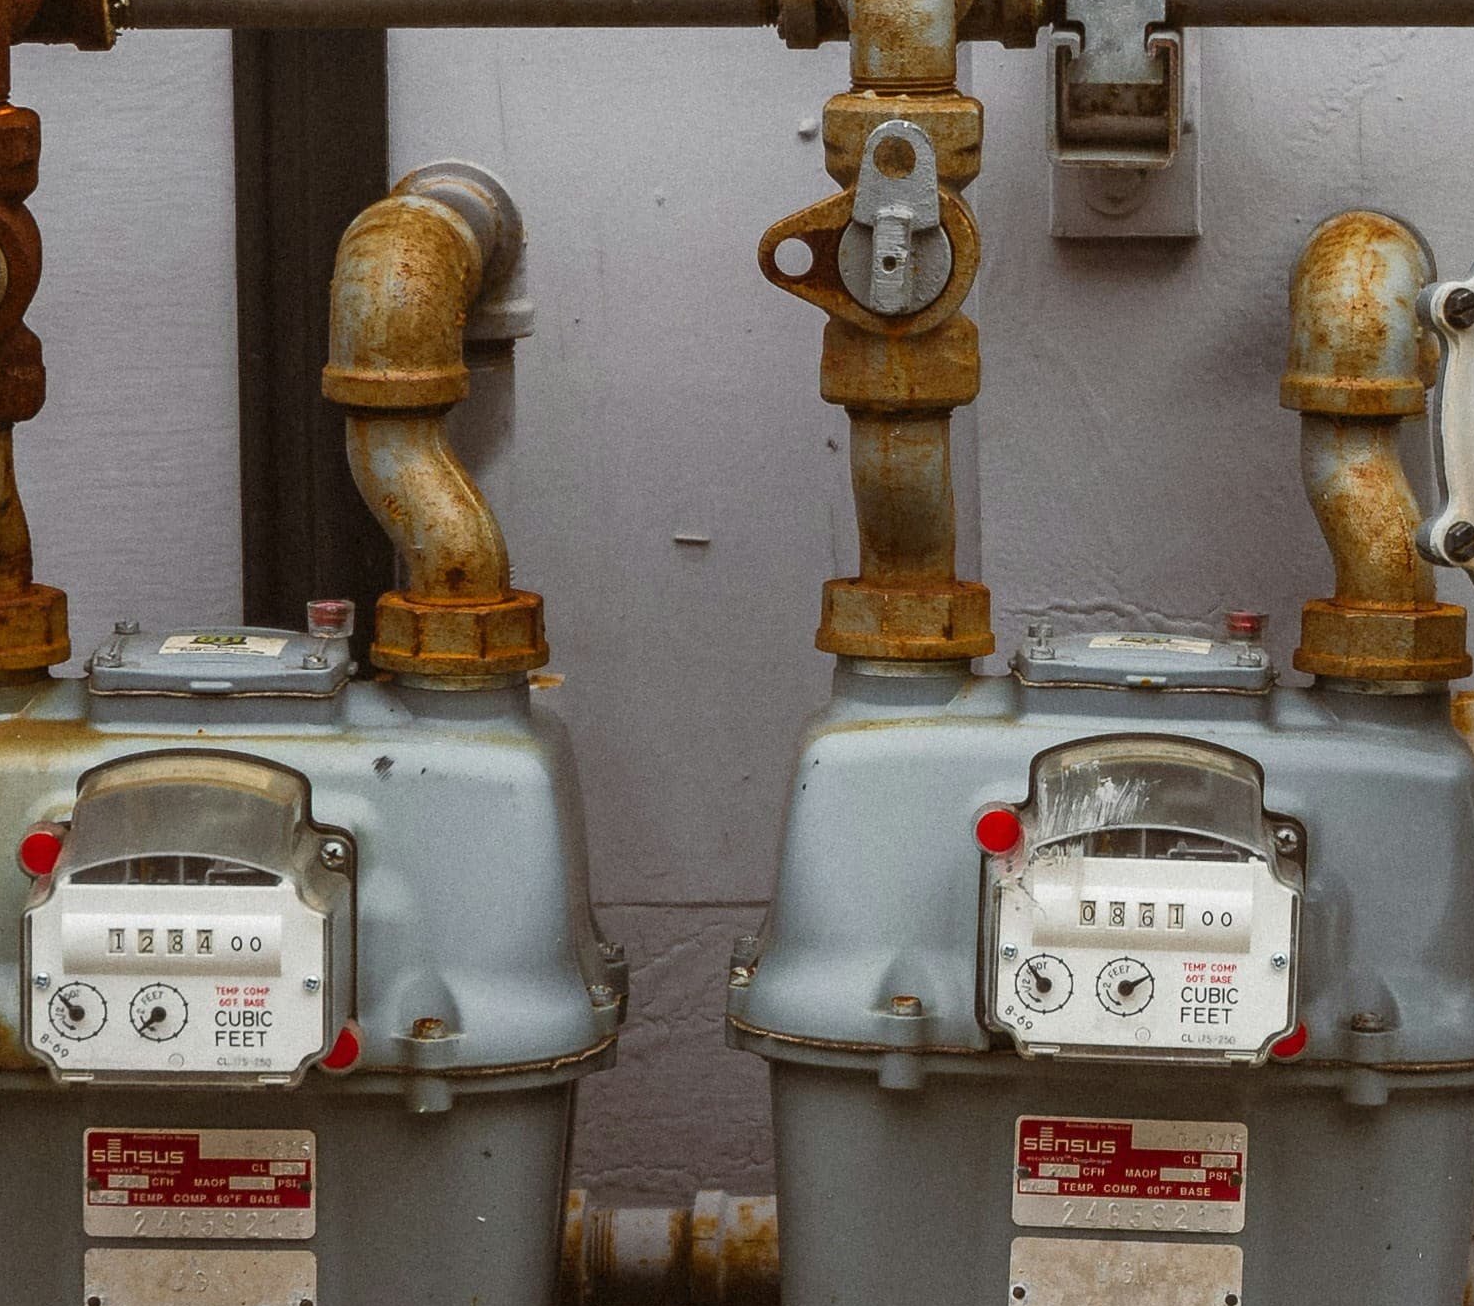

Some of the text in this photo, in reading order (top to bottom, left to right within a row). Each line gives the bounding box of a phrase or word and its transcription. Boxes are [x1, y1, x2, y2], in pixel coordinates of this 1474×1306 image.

[1081, 904, 1182, 927] 0861
[113, 931, 214, 954] 1284
[1107, 964, 1131, 979] FEET
[1210, 975, 1233, 984] BASE
[140, 990, 164, 1005] FEET
[243, 997, 266, 1008] BASE
[1180, 986, 1239, 1005] CUBIC
[214, 1010, 273, 1028] CUBIC
[1004, 1005, 1034, 1031] 8-69
[1180, 1006, 1233, 1025] FEET
[39, 1032, 70, 1060] 8-69
[215, 1030, 268, 1047] FEET
[1183, 1155, 1198, 1165] CL
[251, 1163, 267, 1173] CL
[1082, 1167, 1105, 1177] CFH
[1125, 1168, 1158, 1178] MAOP
[1208, 1171, 1228, 1181] PSI
[151, 1177, 174, 1187] CFH
[194, 1178, 227, 1187] MAOP
[277, 1178, 297, 1188] PSI
[1062, 1182, 1096, 1192] TEMP.
[1103, 1184, 1139, 1194] COMP.
[1147, 1185, 1172, 1195] 60°F
[1180, 1186, 1211, 1197] BASE
[133, 1193, 166, 1203] TEMP.
[173, 1194, 209, 1204] COMP.
[249, 1195, 280, 1204] BASE
